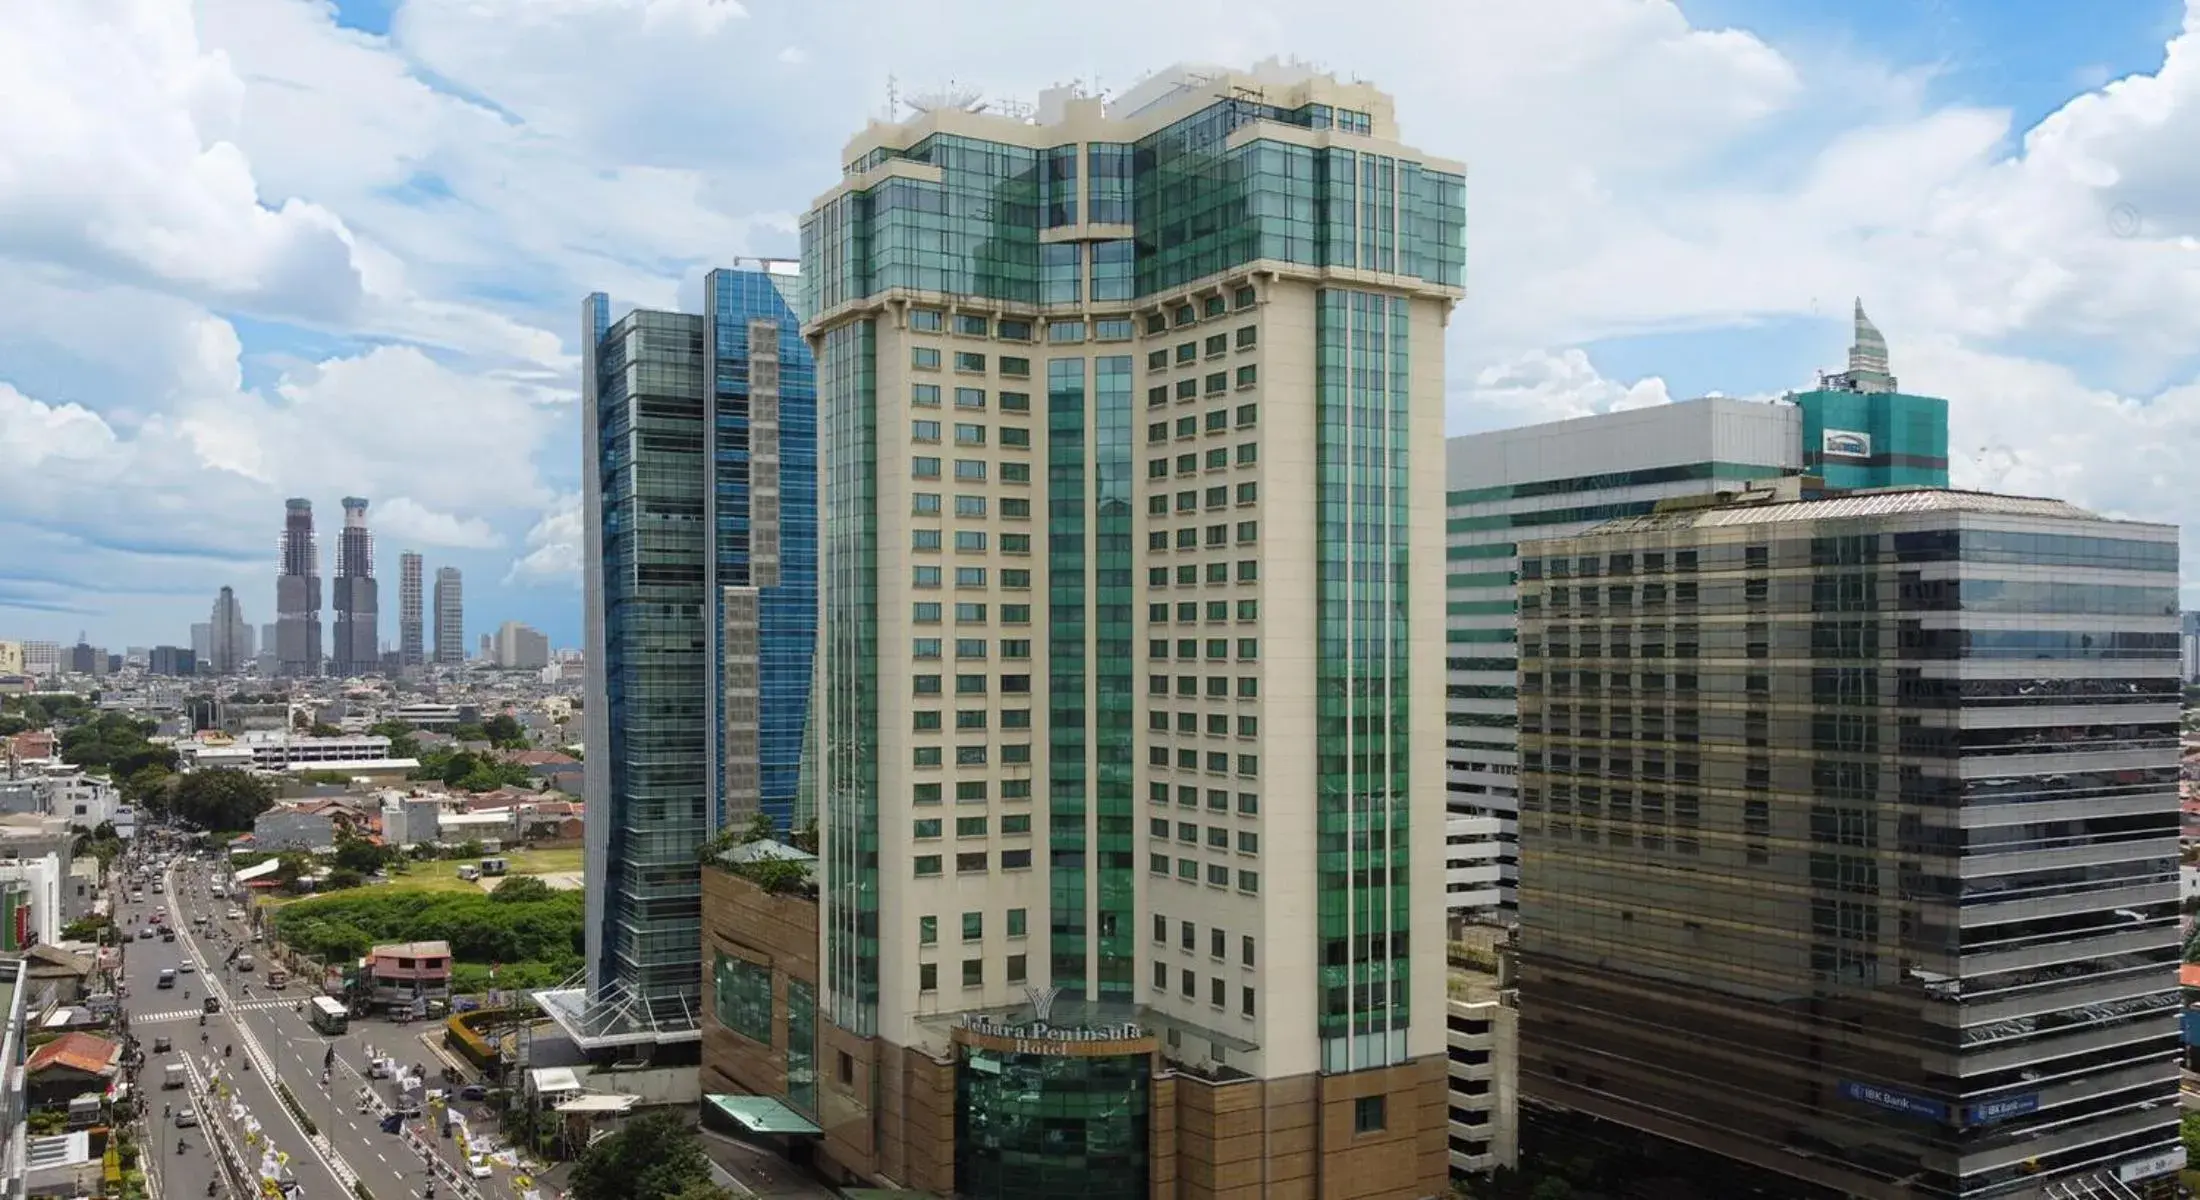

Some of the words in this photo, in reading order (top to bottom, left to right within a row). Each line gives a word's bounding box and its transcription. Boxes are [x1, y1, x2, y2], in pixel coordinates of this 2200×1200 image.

[1033, 1021, 1142, 1041] Peninsula
[1017, 1039, 1067, 1056] Hotel
[1865, 1087, 1882, 1101] IBK
[1883, 1093, 1911, 1109] Bank
[1988, 1103, 1999, 1115] IBK
[2000, 1100, 2018, 1112] Bank
